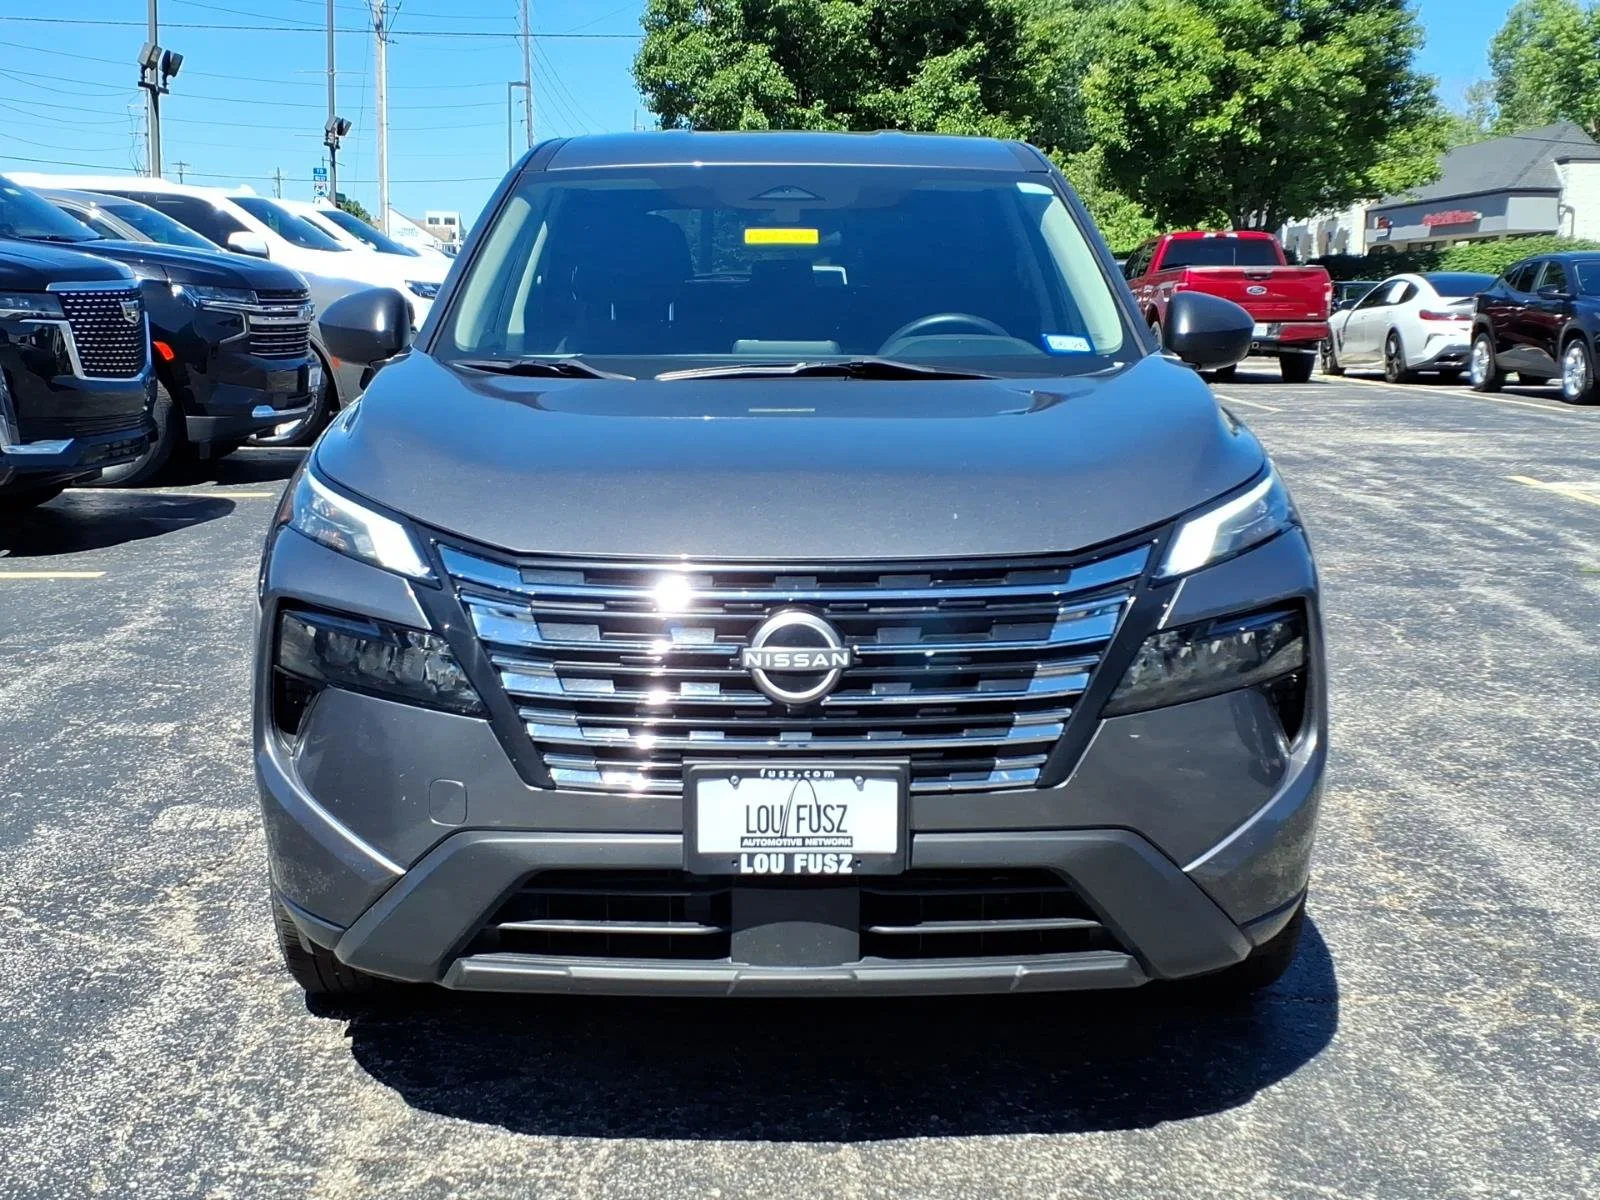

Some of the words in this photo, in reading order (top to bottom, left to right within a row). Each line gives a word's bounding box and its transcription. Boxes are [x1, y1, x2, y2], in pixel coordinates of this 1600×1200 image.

[745, 652, 849, 667] NISSAN
[760, 769, 835, 778] fusz.com
[746, 805, 784, 833] LOU
[796, 804, 848, 833] FUSZ
[742, 838, 803, 847] AUTOMOTIVE
[805, 838, 852, 847] NETWORK
[740, 853, 785, 874] LOU
[794, 853, 853, 874] FUSZ
